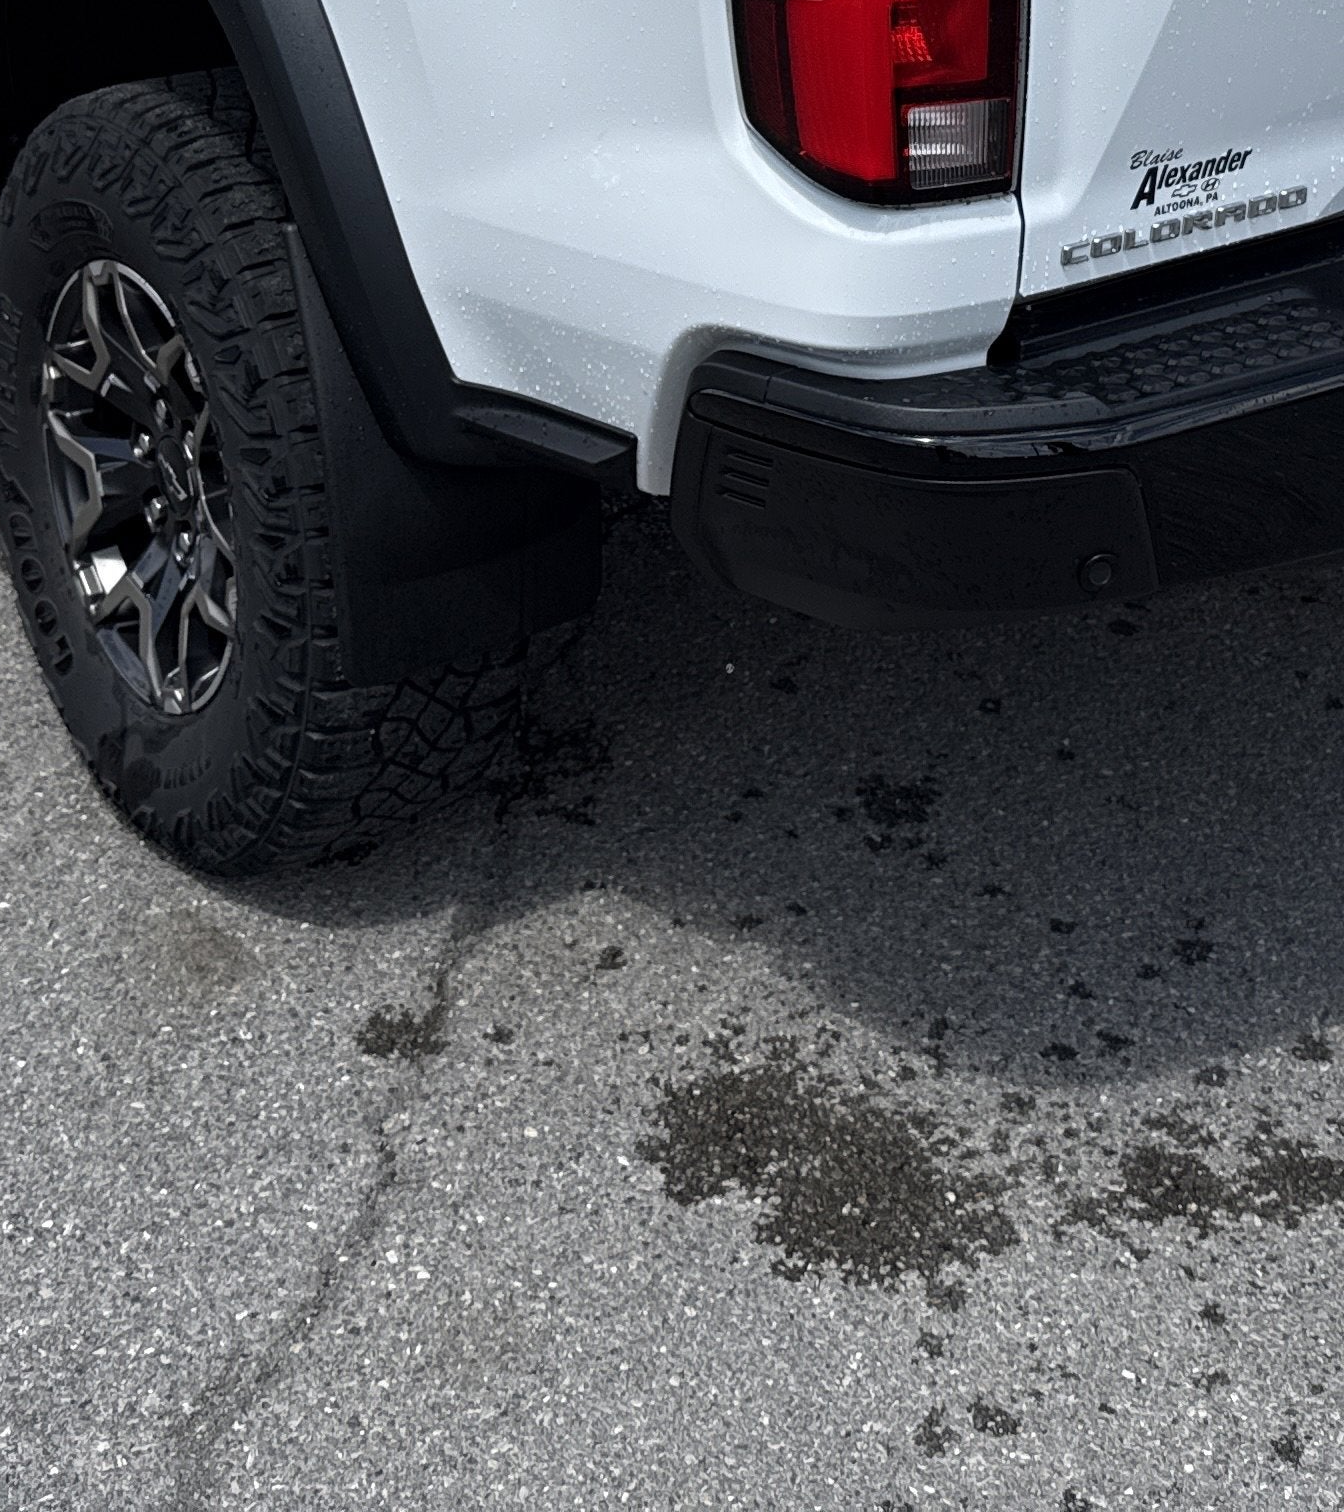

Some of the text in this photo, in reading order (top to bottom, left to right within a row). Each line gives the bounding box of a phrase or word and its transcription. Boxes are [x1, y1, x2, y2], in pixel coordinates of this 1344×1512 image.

[1130, 147, 1184, 171] Blaise
[1130, 147, 1254, 211] Alexander
[1206, 191, 1218, 204] PA
[1060, 185, 1308, 266] COLORADO
